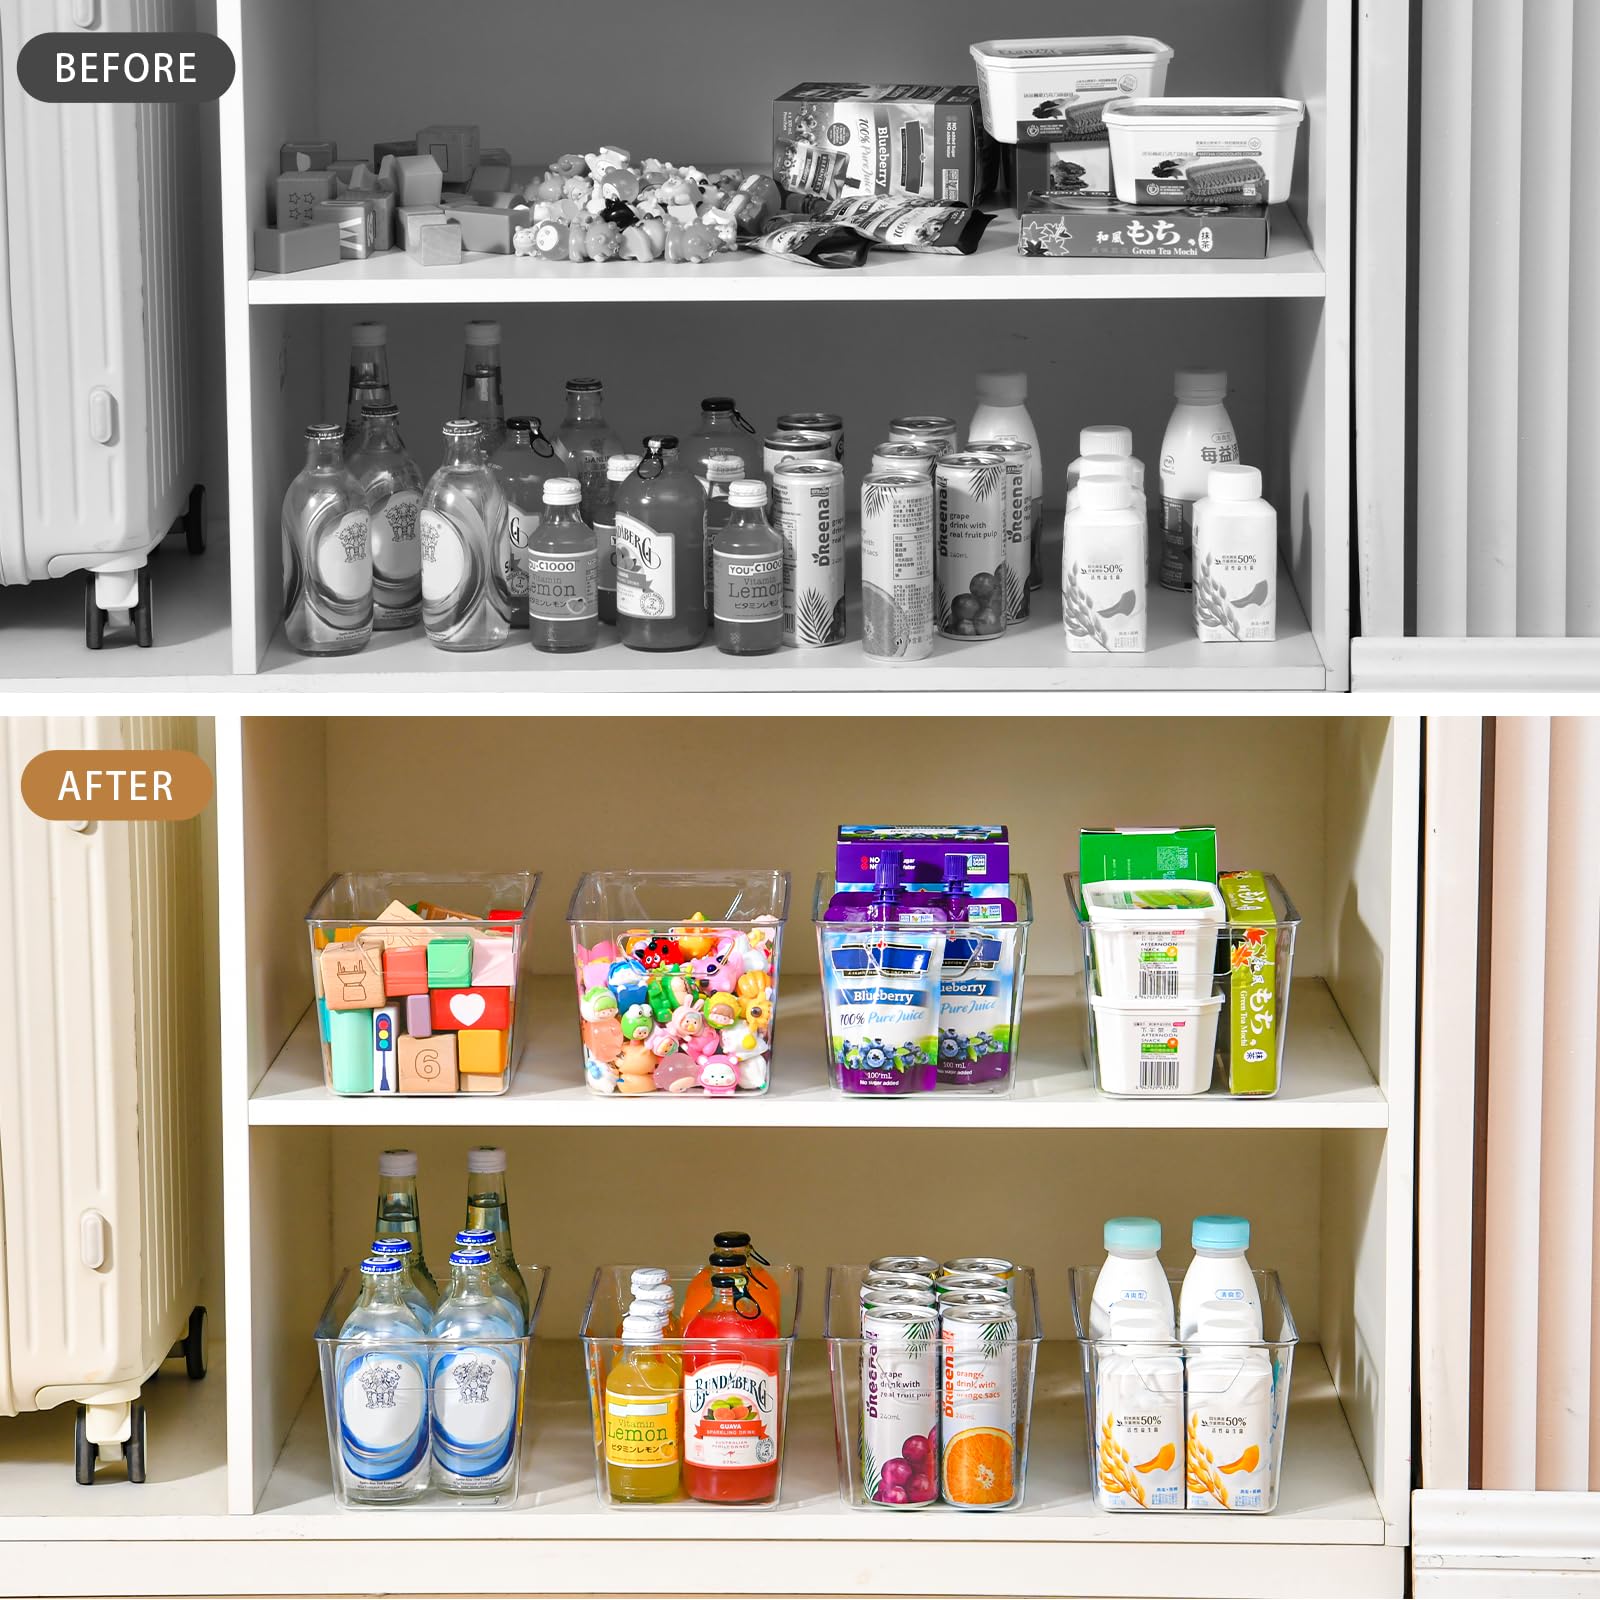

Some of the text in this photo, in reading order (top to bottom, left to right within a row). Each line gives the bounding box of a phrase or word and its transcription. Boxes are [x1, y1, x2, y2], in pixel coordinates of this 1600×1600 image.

[858, 118, 870, 144] 100%
[876, 126, 890, 188] Blueberry
[1132, 247, 1156, 256] Green
[1158, 248, 1172, 256] Tea
[1174, 248, 1198, 256] Mochi
[949, 513, 970, 521] grape
[983, 530, 998, 540] pulp
[1237, 554, 1256, 564] 50%
[1103, 564, 1123, 574] 50%
[531, 582, 576, 597] emon
[854, 990, 914, 1005] Blueberry
[940, 1000, 996, 1014] Pure Juice
[840, 1009, 924, 1026] 100% Pure Juice
[1240, 990, 1248, 1046] Green Tea Mochi
[414, 1048, 440, 1080] 6
[956, 1370, 984, 1380] orange
[690, 1372, 774, 1413] BUNDABERG
[618, 1419, 654, 1428] Vitamin
[1140, 1416, 1162, 1425] 50%
[1226, 1416, 1246, 1426] 50%
[608, 1422, 668, 1442] Lemon
[612, 1444, 660, 1454] ビタミンレモン
